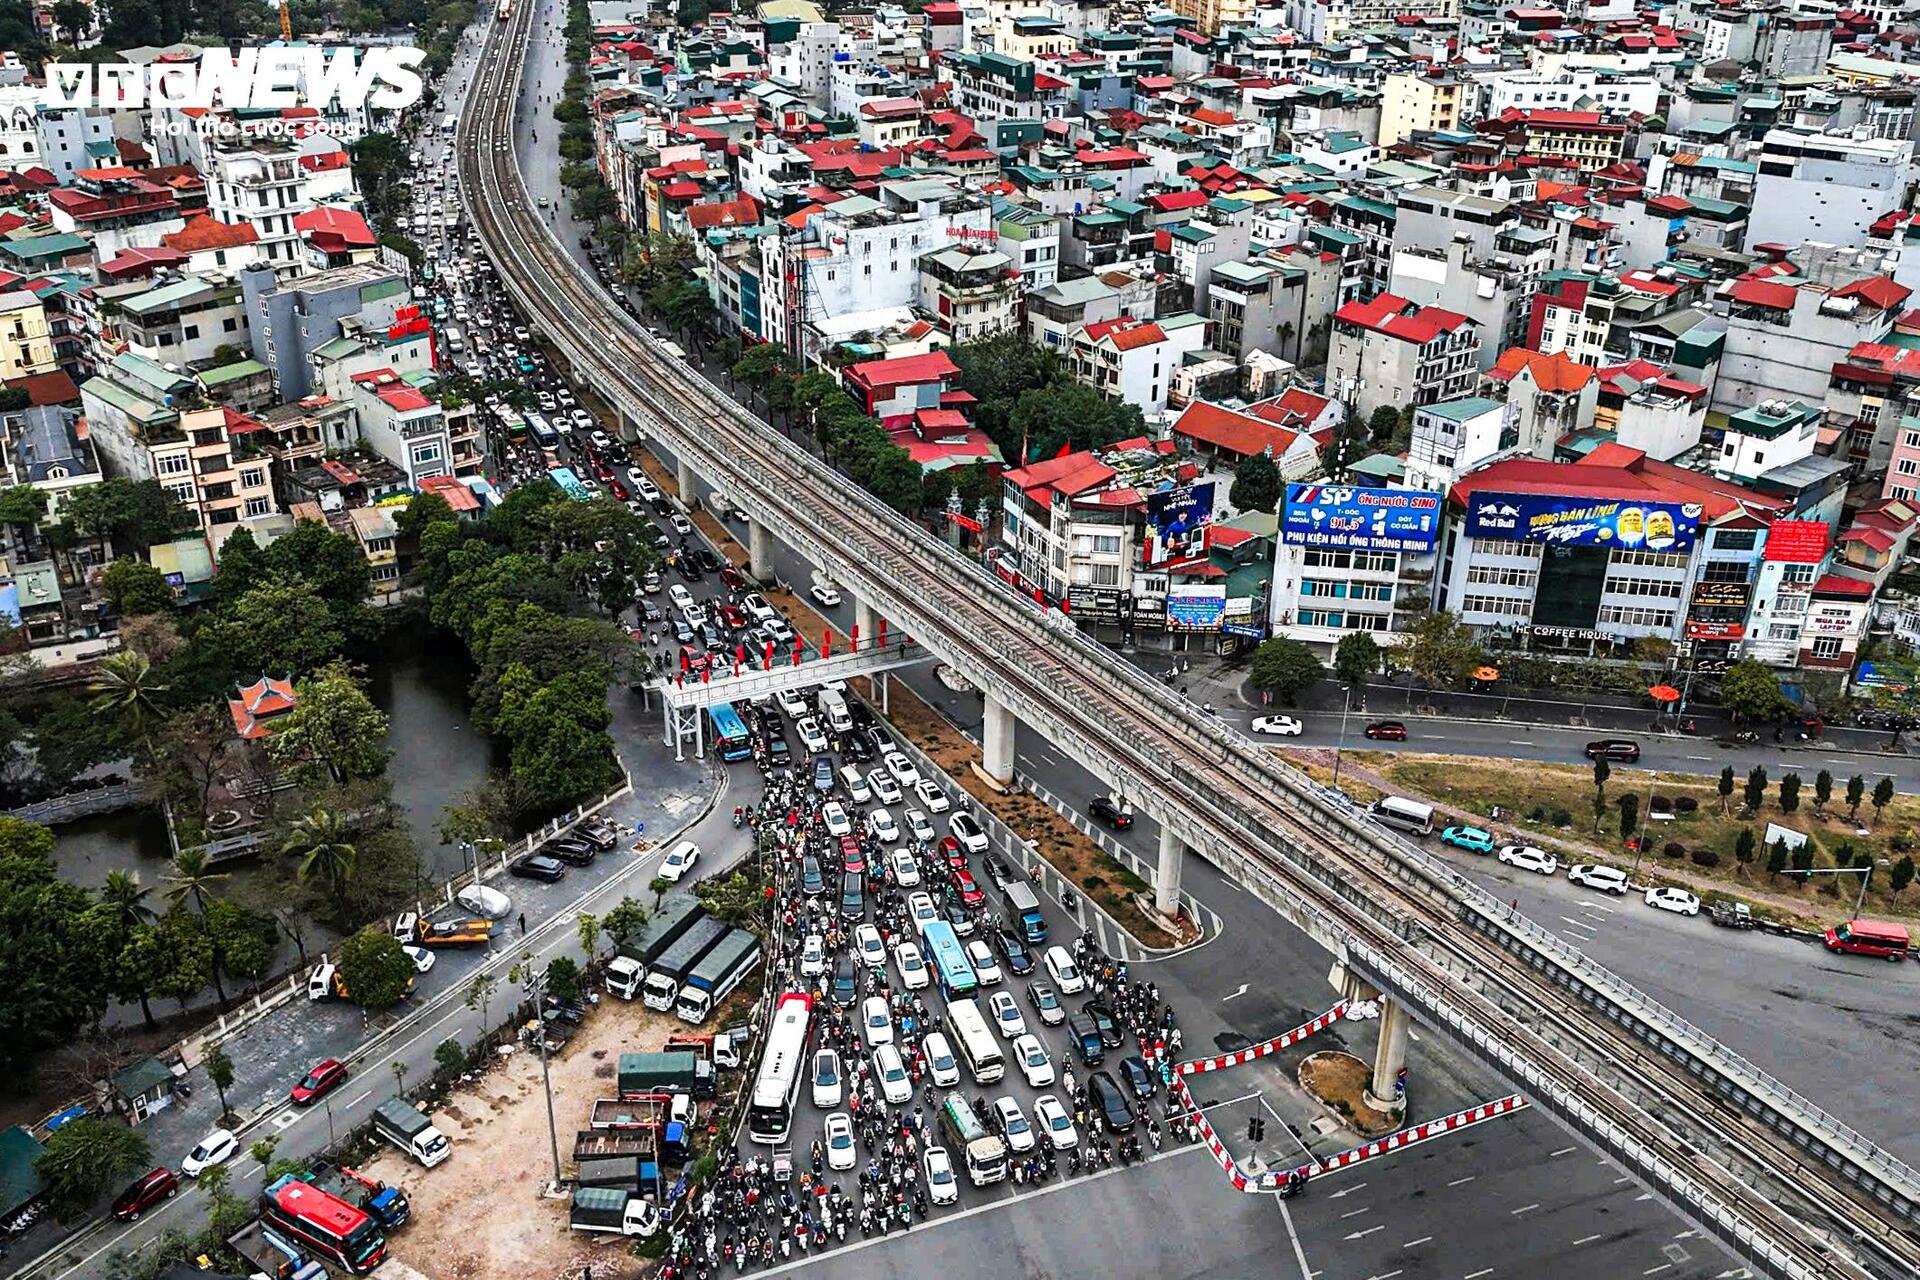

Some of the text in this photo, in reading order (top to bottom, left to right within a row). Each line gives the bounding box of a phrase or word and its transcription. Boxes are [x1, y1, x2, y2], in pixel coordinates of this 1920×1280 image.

[1319, 487, 1352, 506] SP
[1410, 497, 1437, 509] SINO
[1479, 517, 1515, 528] Red Bull
[1402, 540, 1428, 550] MINH
[1533, 626, 1576, 638] COFFEE
[1578, 629, 1614, 641] HOUSE
